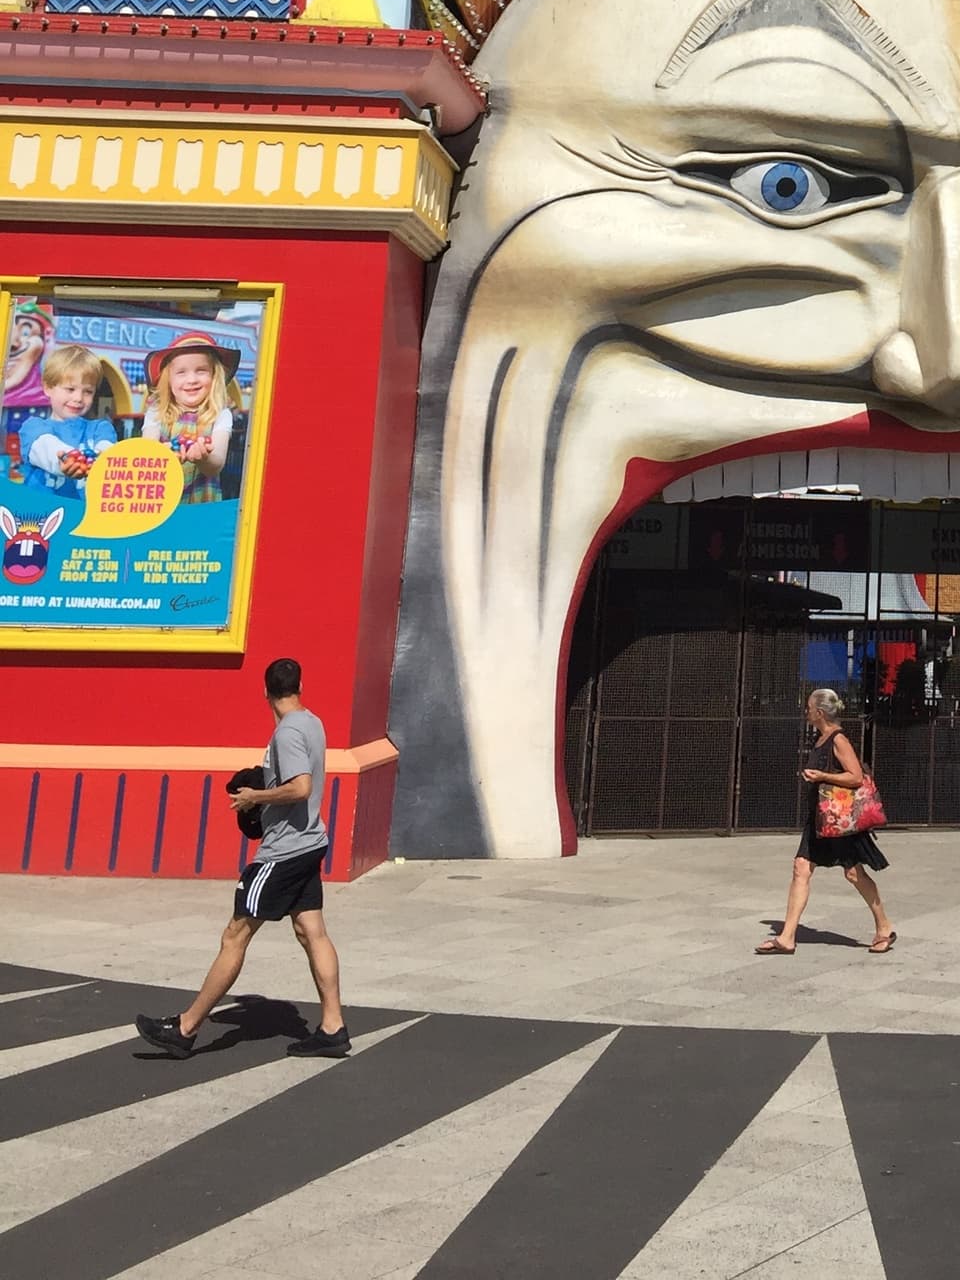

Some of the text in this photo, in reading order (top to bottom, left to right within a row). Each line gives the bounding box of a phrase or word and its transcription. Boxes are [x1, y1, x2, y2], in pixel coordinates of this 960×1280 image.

[70, 316, 159, 348] SCENIC
[107, 457, 169, 468] THE GREAT
[104, 470, 167, 481] LUNA PARK
[101, 483, 165, 499] EASTER
[100, 502, 163, 513] EGG HUNT
[71, 548, 111, 560] EASTER
[148, 550, 209, 562] FREE ENTRY
[62, 560, 82, 571] SAT
[97, 560, 119, 571] SUN
[134, 561, 222, 573] WITH UNLIMITED
[59, 571, 118, 583] FROM 12PM
[143, 572, 209, 584] RIDE TICKET
[21, 595, 46, 607] INFO
[48, 596, 63, 608] AT
[65, 597, 161, 609] LUNAPARK.COM.AU
